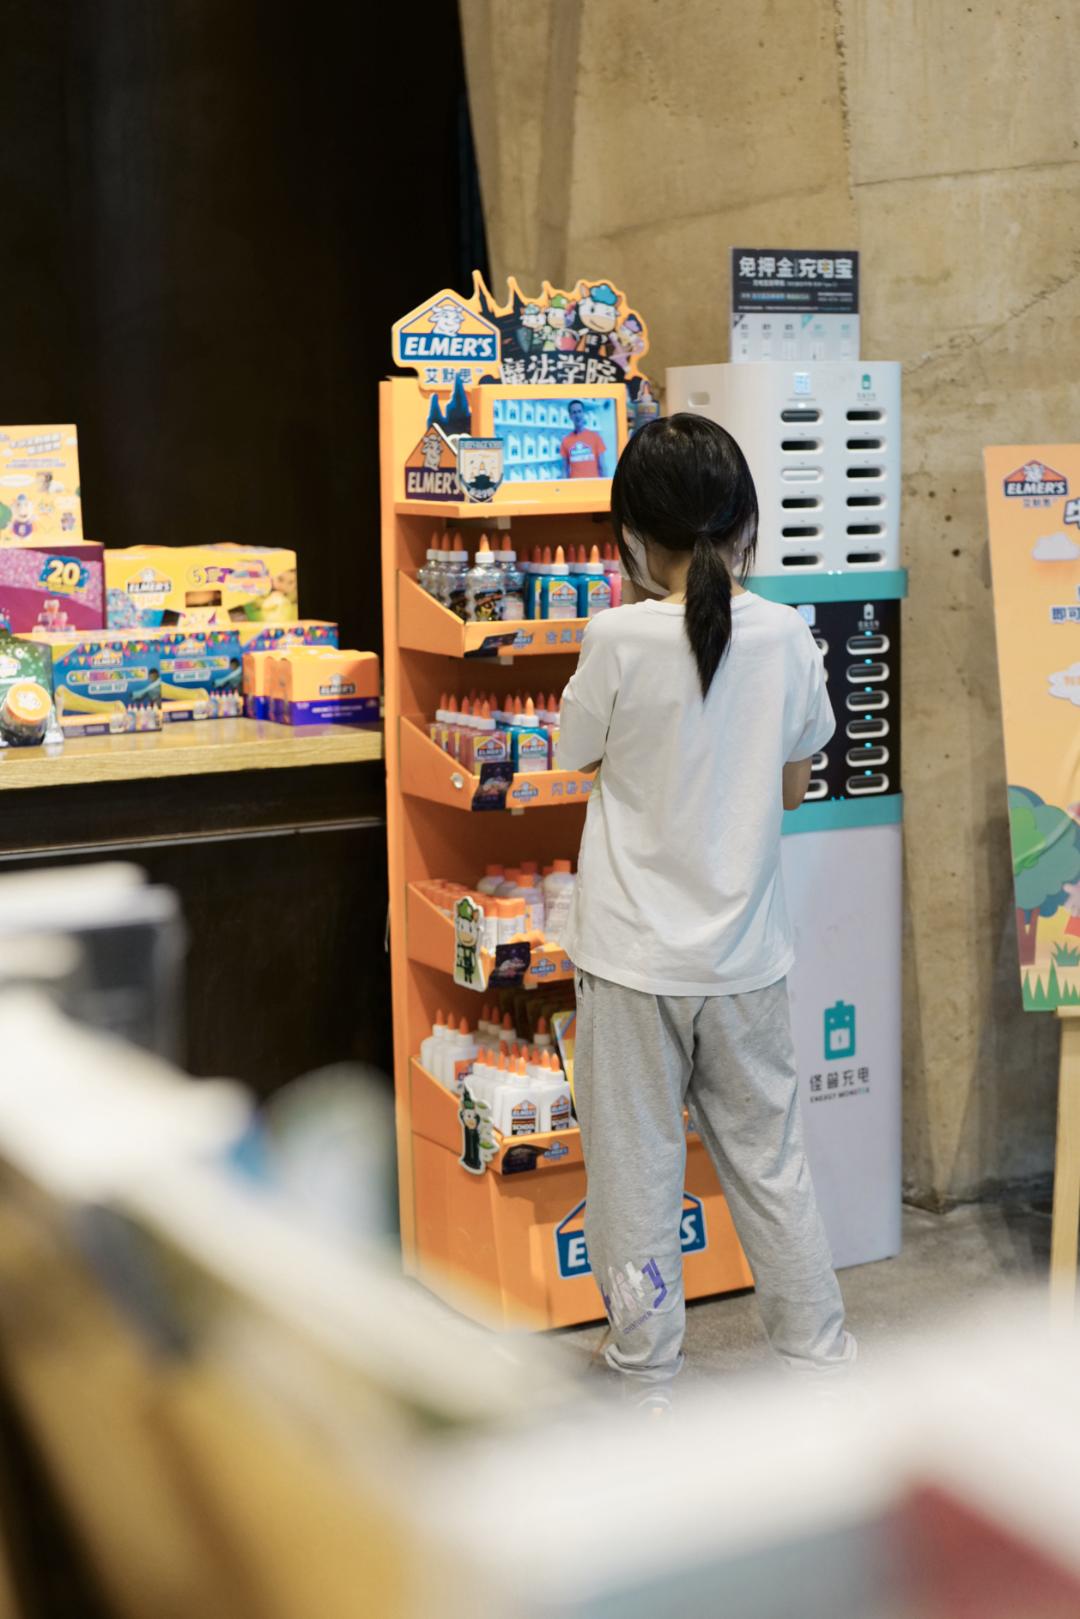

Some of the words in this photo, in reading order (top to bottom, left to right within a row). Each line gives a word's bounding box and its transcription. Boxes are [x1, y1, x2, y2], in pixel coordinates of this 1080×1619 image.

[739, 256, 793, 278] 免押金
[798, 258, 853, 279] 充电宝
[404, 337, 493, 357] ELMER'S
[501, 353, 617, 384] 魔法学院
[1007, 481, 1066, 495] ELMER'S
[48, 560, 81, 589] 20
